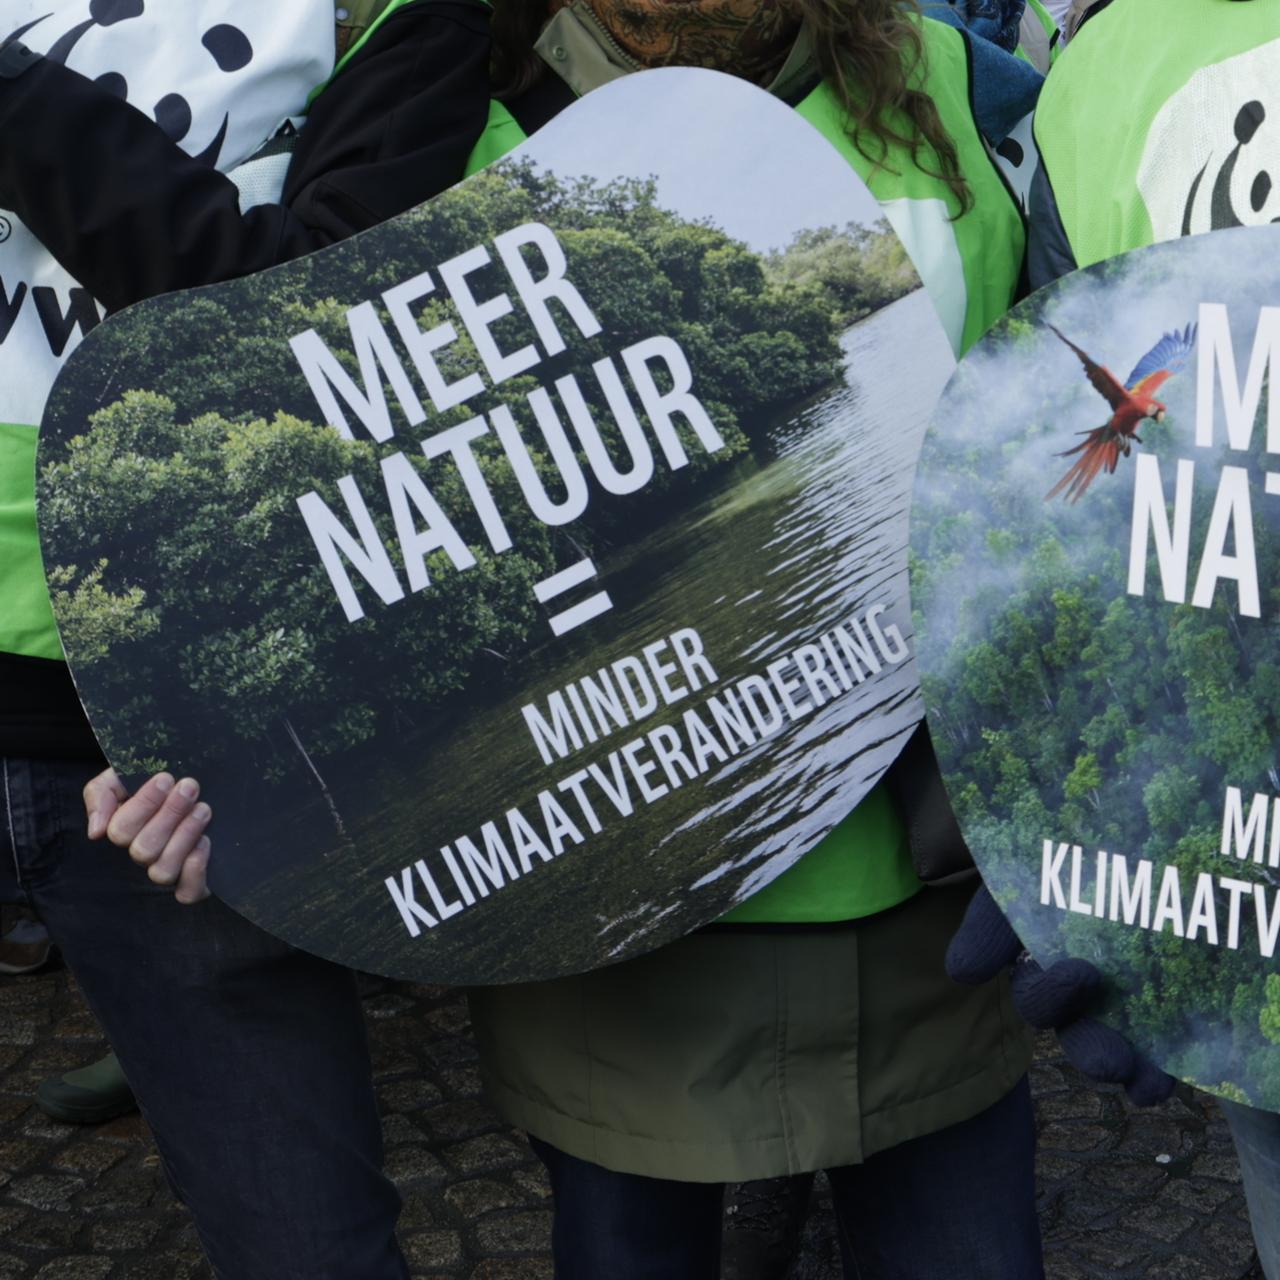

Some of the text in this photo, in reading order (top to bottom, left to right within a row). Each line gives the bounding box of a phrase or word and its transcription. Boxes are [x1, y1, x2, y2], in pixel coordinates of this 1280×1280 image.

[288, 220, 602, 445] MEER
[296, 333, 725, 623] NATUUR
[384, 602, 910, 938] KLIMAATVERANDERING
[521, 626, 719, 766] MINDER
